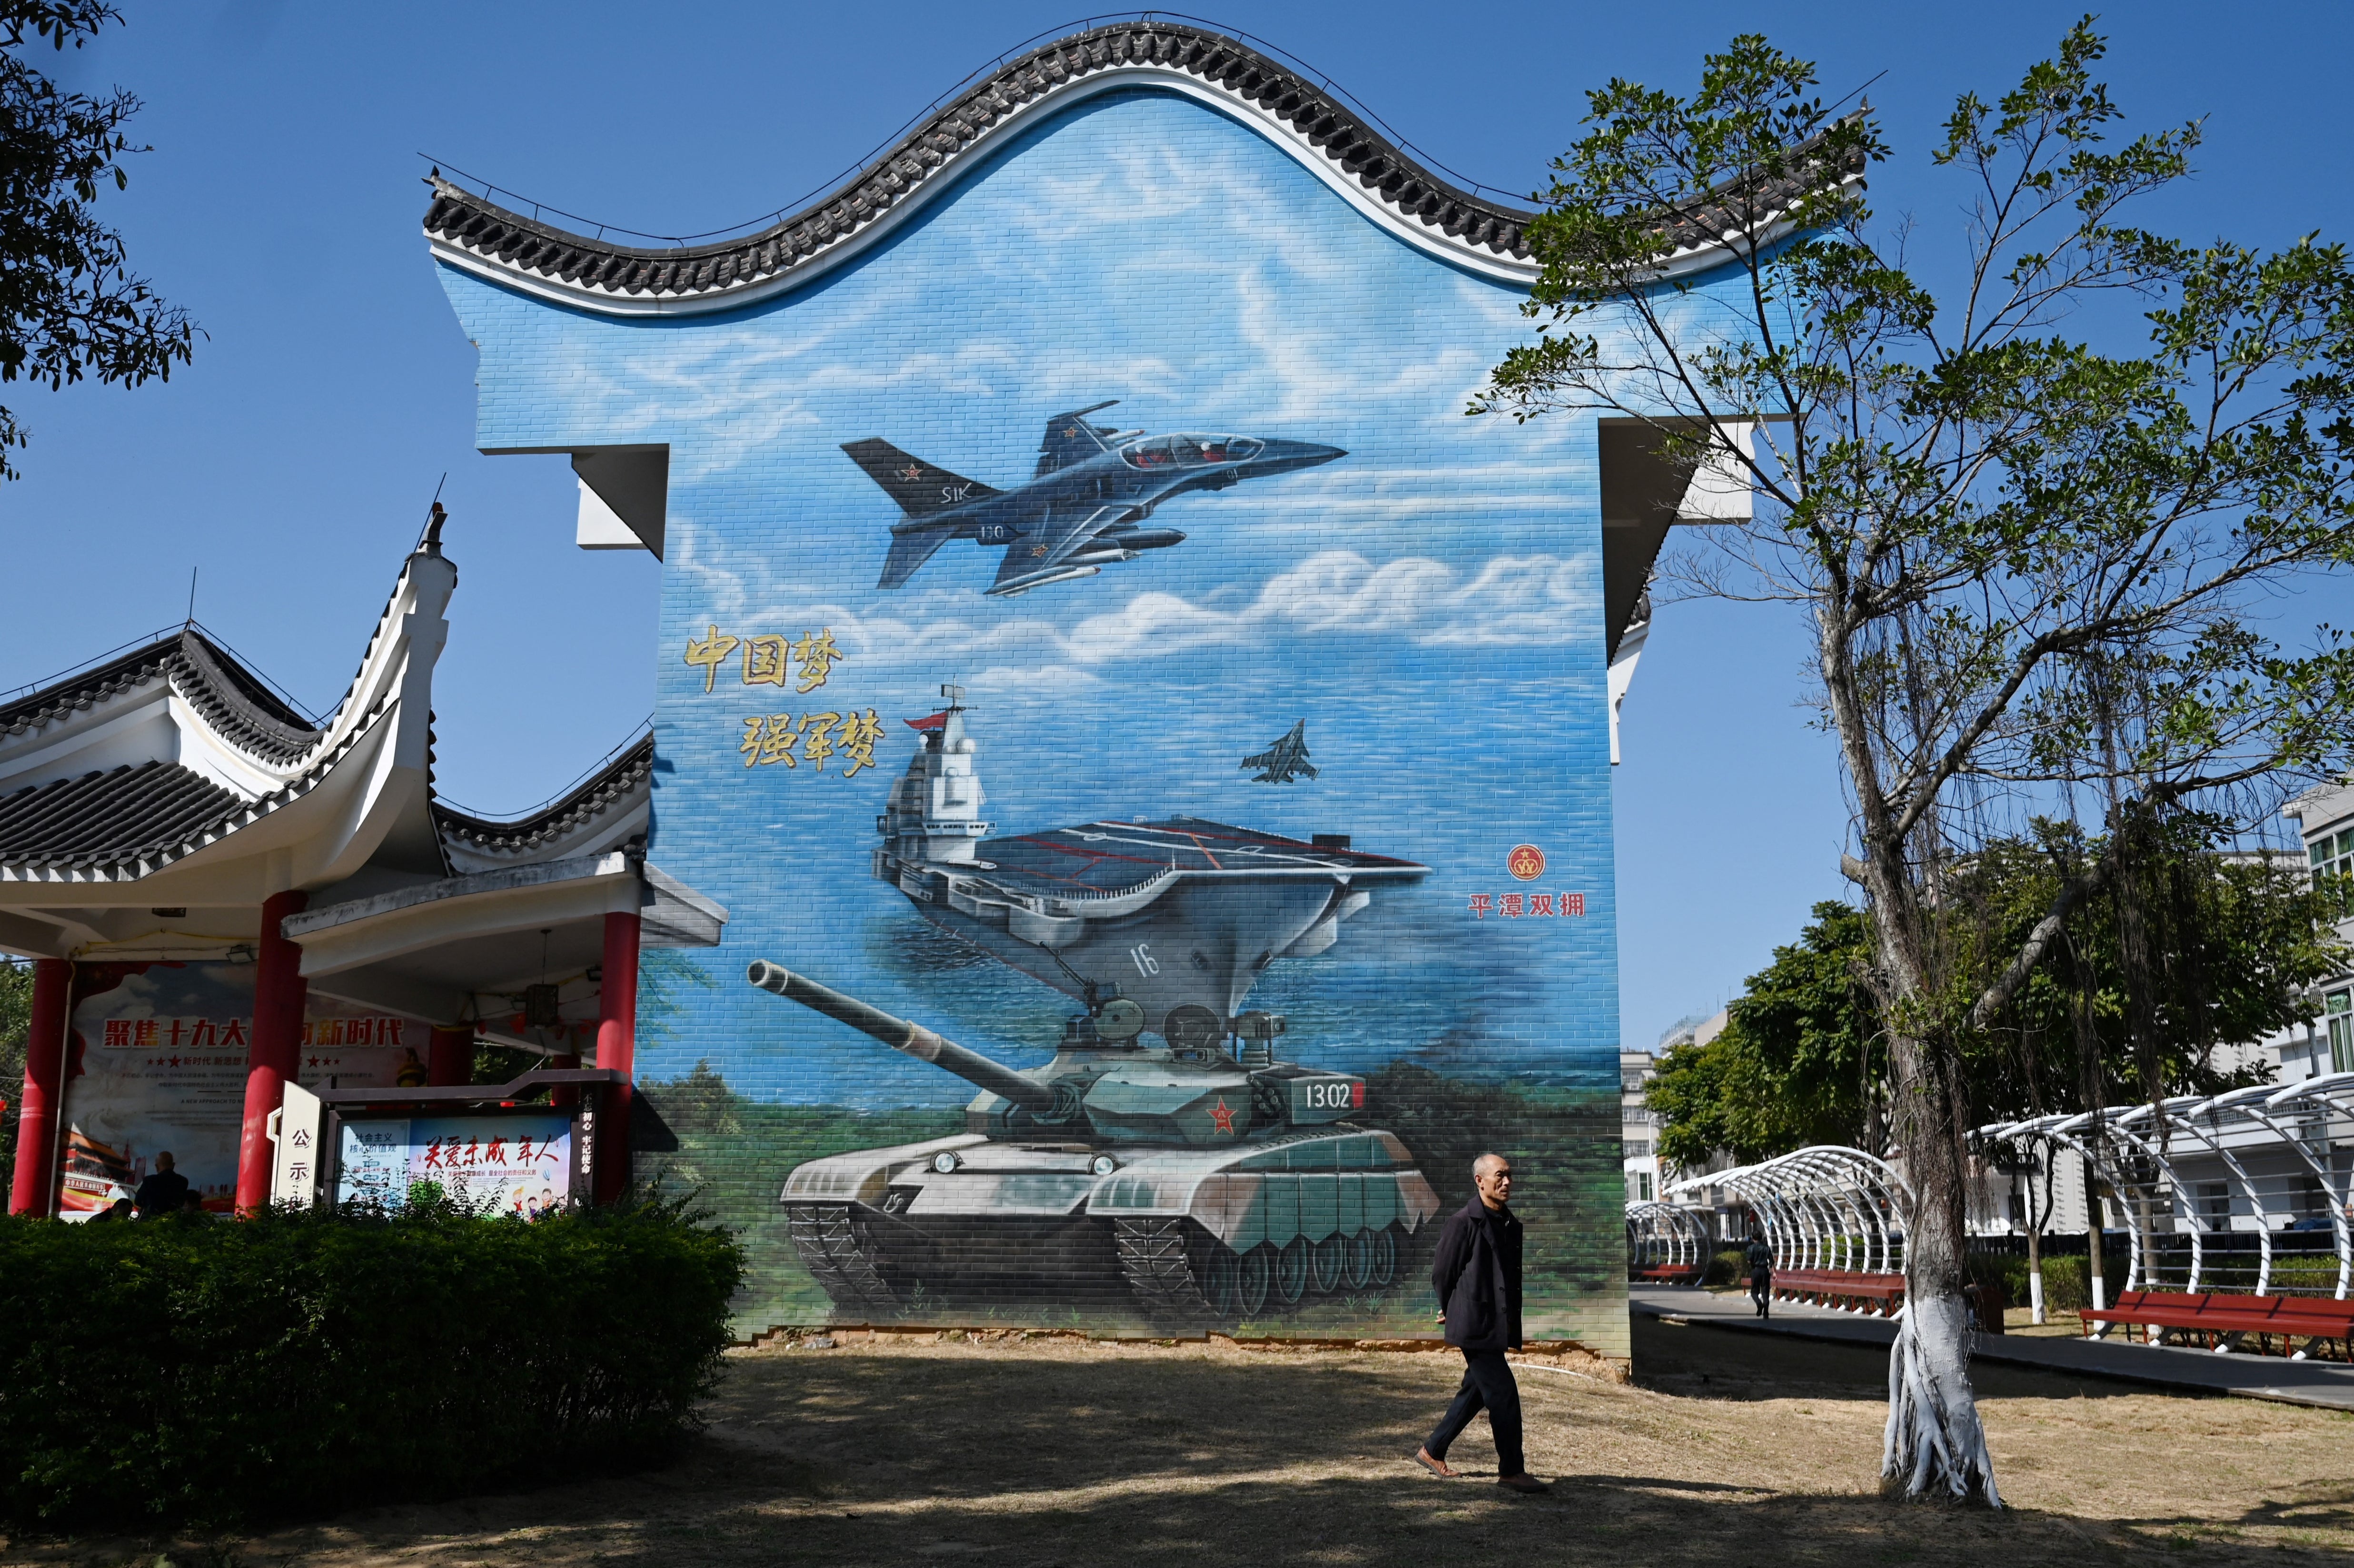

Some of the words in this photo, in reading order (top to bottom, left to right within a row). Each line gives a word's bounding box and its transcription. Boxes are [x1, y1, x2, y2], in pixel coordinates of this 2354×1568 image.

[685, 625, 842, 694] 中国梦
[740, 708, 885, 778] 强军梦
[1468, 893, 1585, 919] 平潭双拥
[1130, 943, 1160, 978] 16
[104, 1019, 248, 1047] 聚焦十九大
[582, 1093, 593, 1131] 不忘初心
[1307, 1082, 1350, 1109] 1302
[349, 1144, 397, 1153] 核心价值观
[356, 1133, 392, 1142] 社会主义
[425, 1134, 559, 1169] 关爱未成年人
[581, 1135, 592, 1174] 牢记使命
